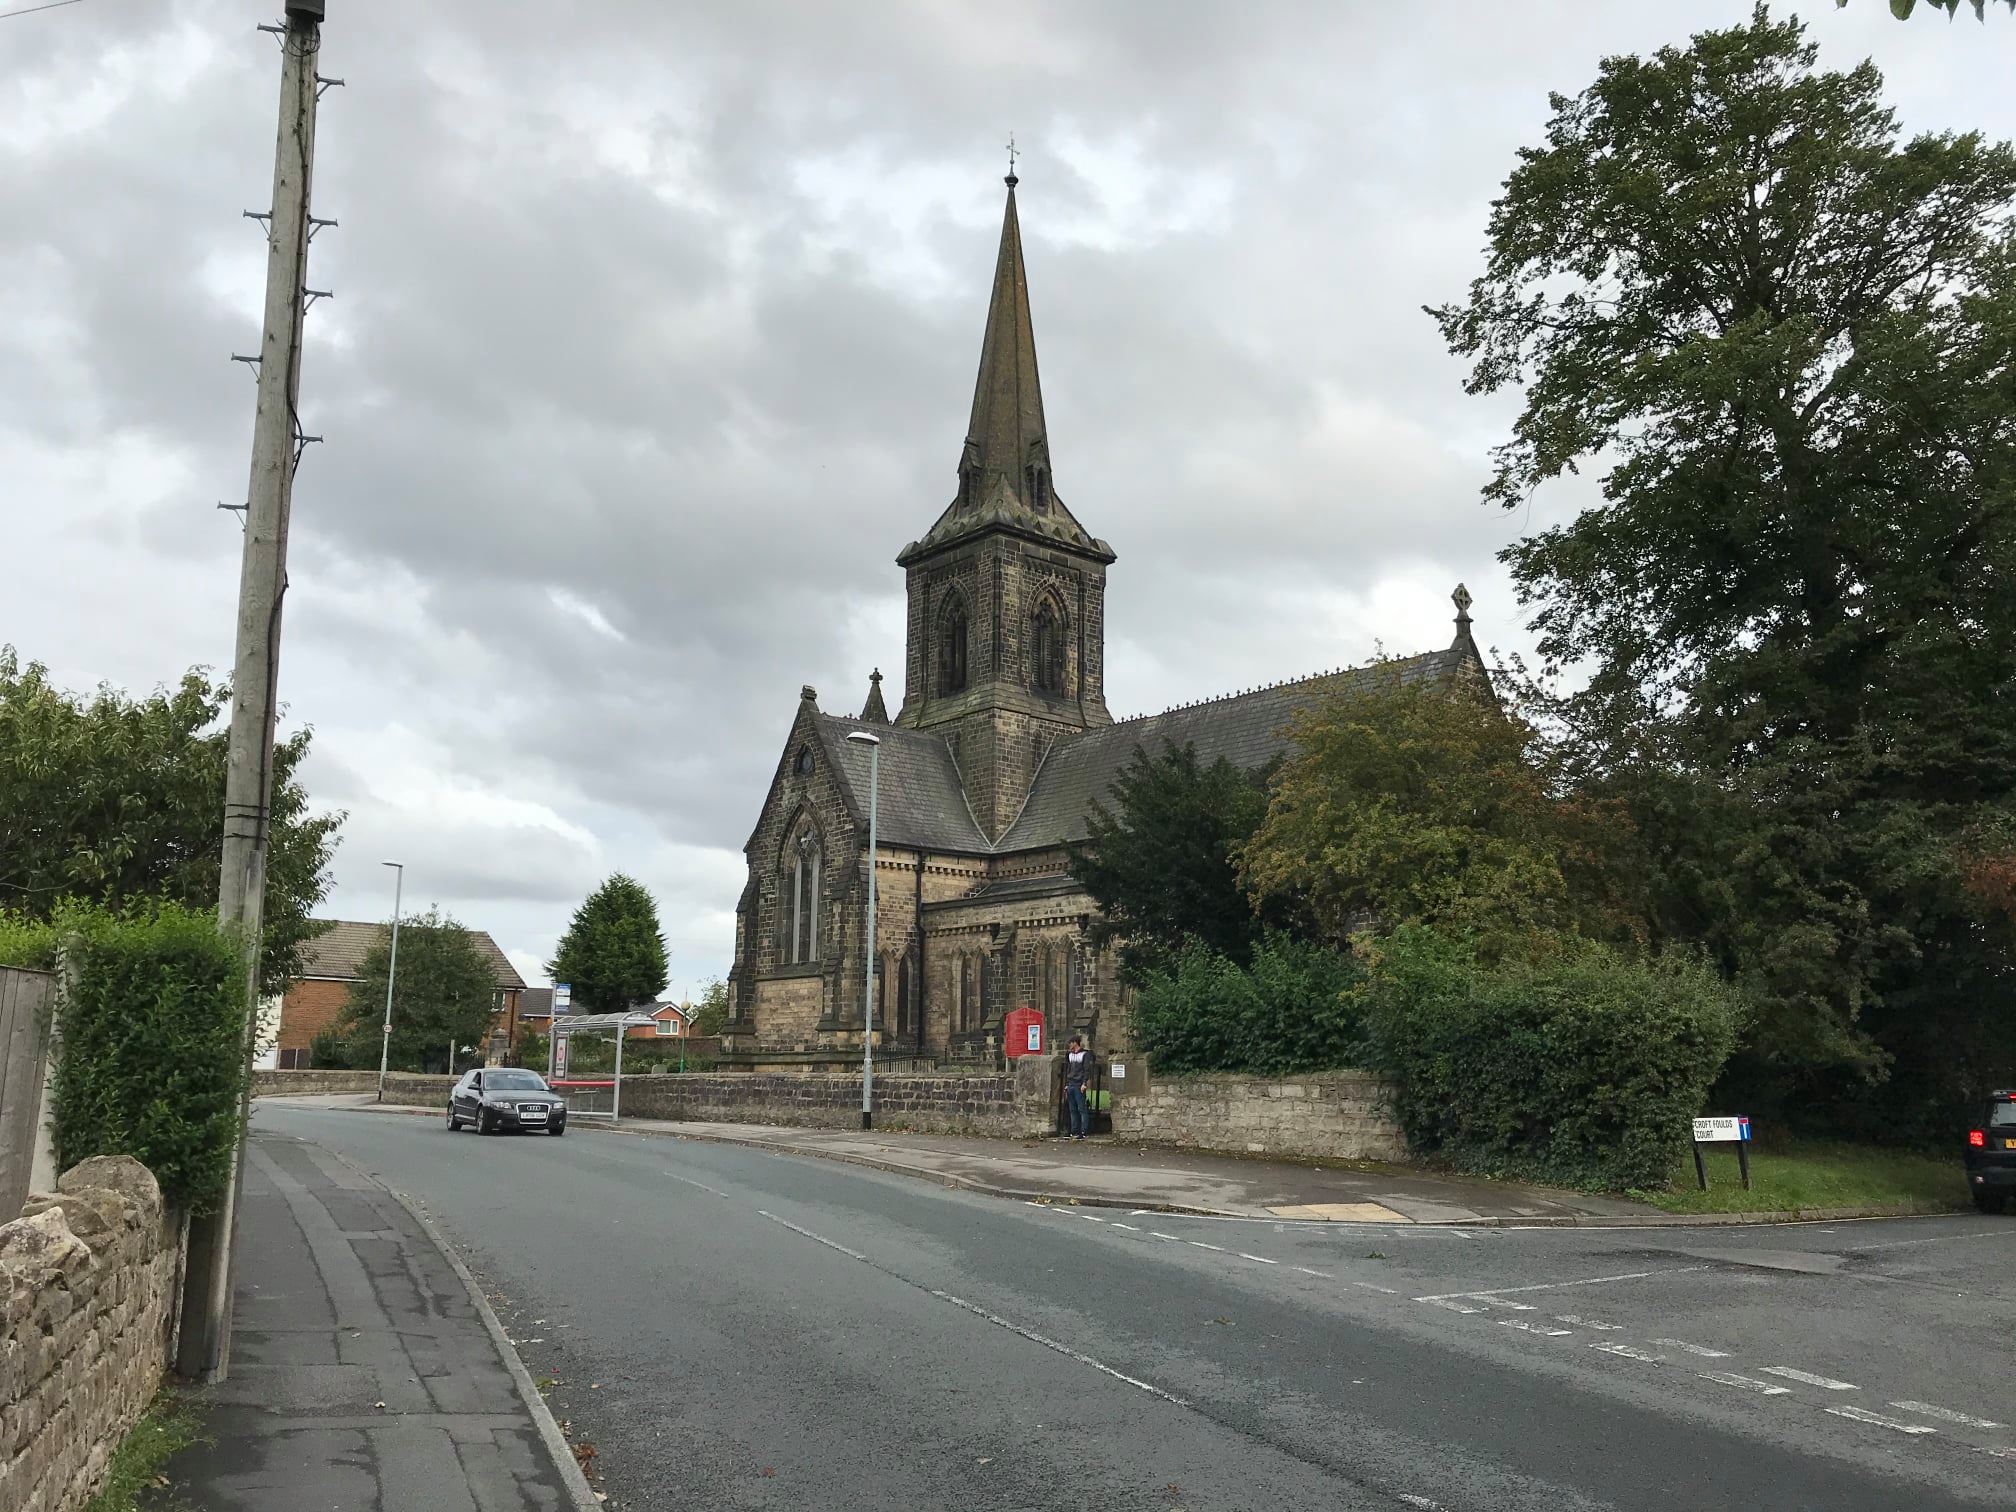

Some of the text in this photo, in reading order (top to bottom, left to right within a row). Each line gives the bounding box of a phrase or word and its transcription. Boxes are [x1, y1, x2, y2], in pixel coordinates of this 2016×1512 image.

[1694, 1119, 1732, 1128] CROFT FOULDS
[1696, 1130, 1713, 1138] COURT
